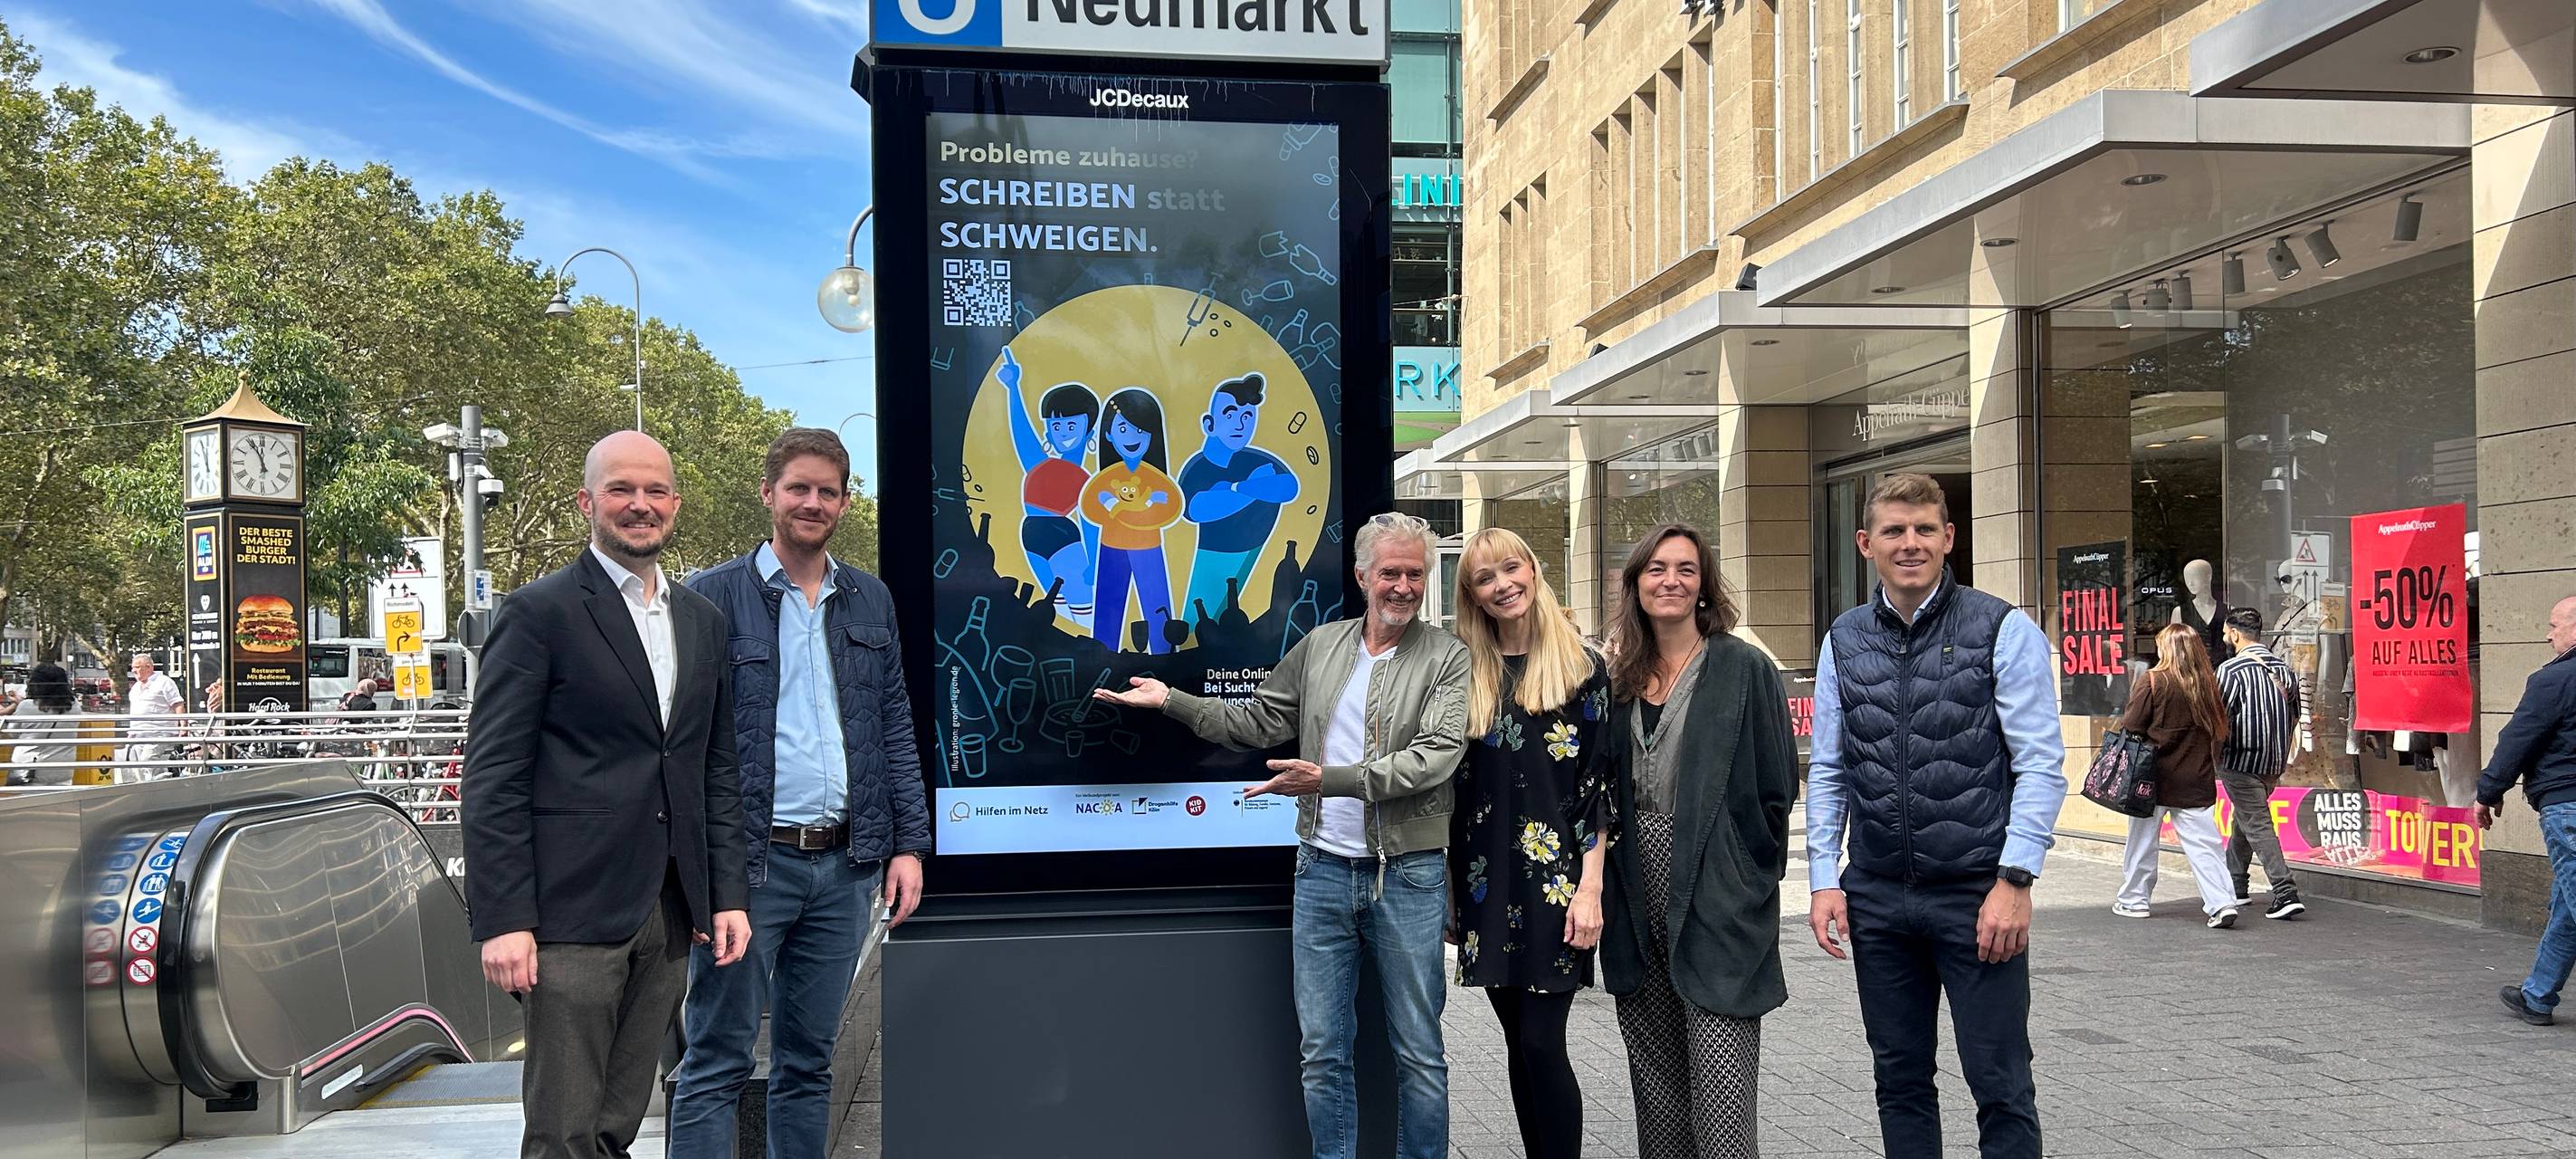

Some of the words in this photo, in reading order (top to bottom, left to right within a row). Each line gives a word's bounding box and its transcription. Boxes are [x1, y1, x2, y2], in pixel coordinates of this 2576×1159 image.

[1027, 0, 1369, 35] Neumarkt
[1090, 88, 1189, 109] JCDecaux
[940, 141, 1071, 166] Probleme
[1079, 146, 1198, 169] zuhause?
[939, 177, 1135, 209] SCHREIBEN
[1147, 187, 1226, 212] statt
[940, 222, 1158, 253] SCHWEIGEN.
[239, 527, 260, 536] DER
[262, 528, 293, 538] BESTE
[241, 536, 291, 547] SMASHED
[245, 546, 287, 555] BURGER
[197, 556, 213, 567] ALDI
[237, 554, 257, 563] DER
[259, 555, 296, 565] STADT!
[2062, 587, 2123, 632] FINAL
[2063, 634, 2125, 675] SALE
[2372, 640, 2401, 666] AUF
[2409, 639, 2457, 665] ALLES
[1207, 667, 1239, 679] Deine
[1204, 681, 1222, 693] Bei
[1225, 681, 1255, 693] Sucht
[249, 702, 271, 712] Hard
[270, 702, 291, 713] Rock
[1188, 799, 1202, 807] KID
[1189, 805, 1202, 814] KIT
[2314, 792, 2361, 812] ALLES
[976, 806, 1007, 816] Hilfen
[1008, 806, 1022, 815] im
[1024, 806, 1048, 815] Netz
[2316, 811, 2361, 831] MUSS
[2320, 830, 2361, 849] RAUS
